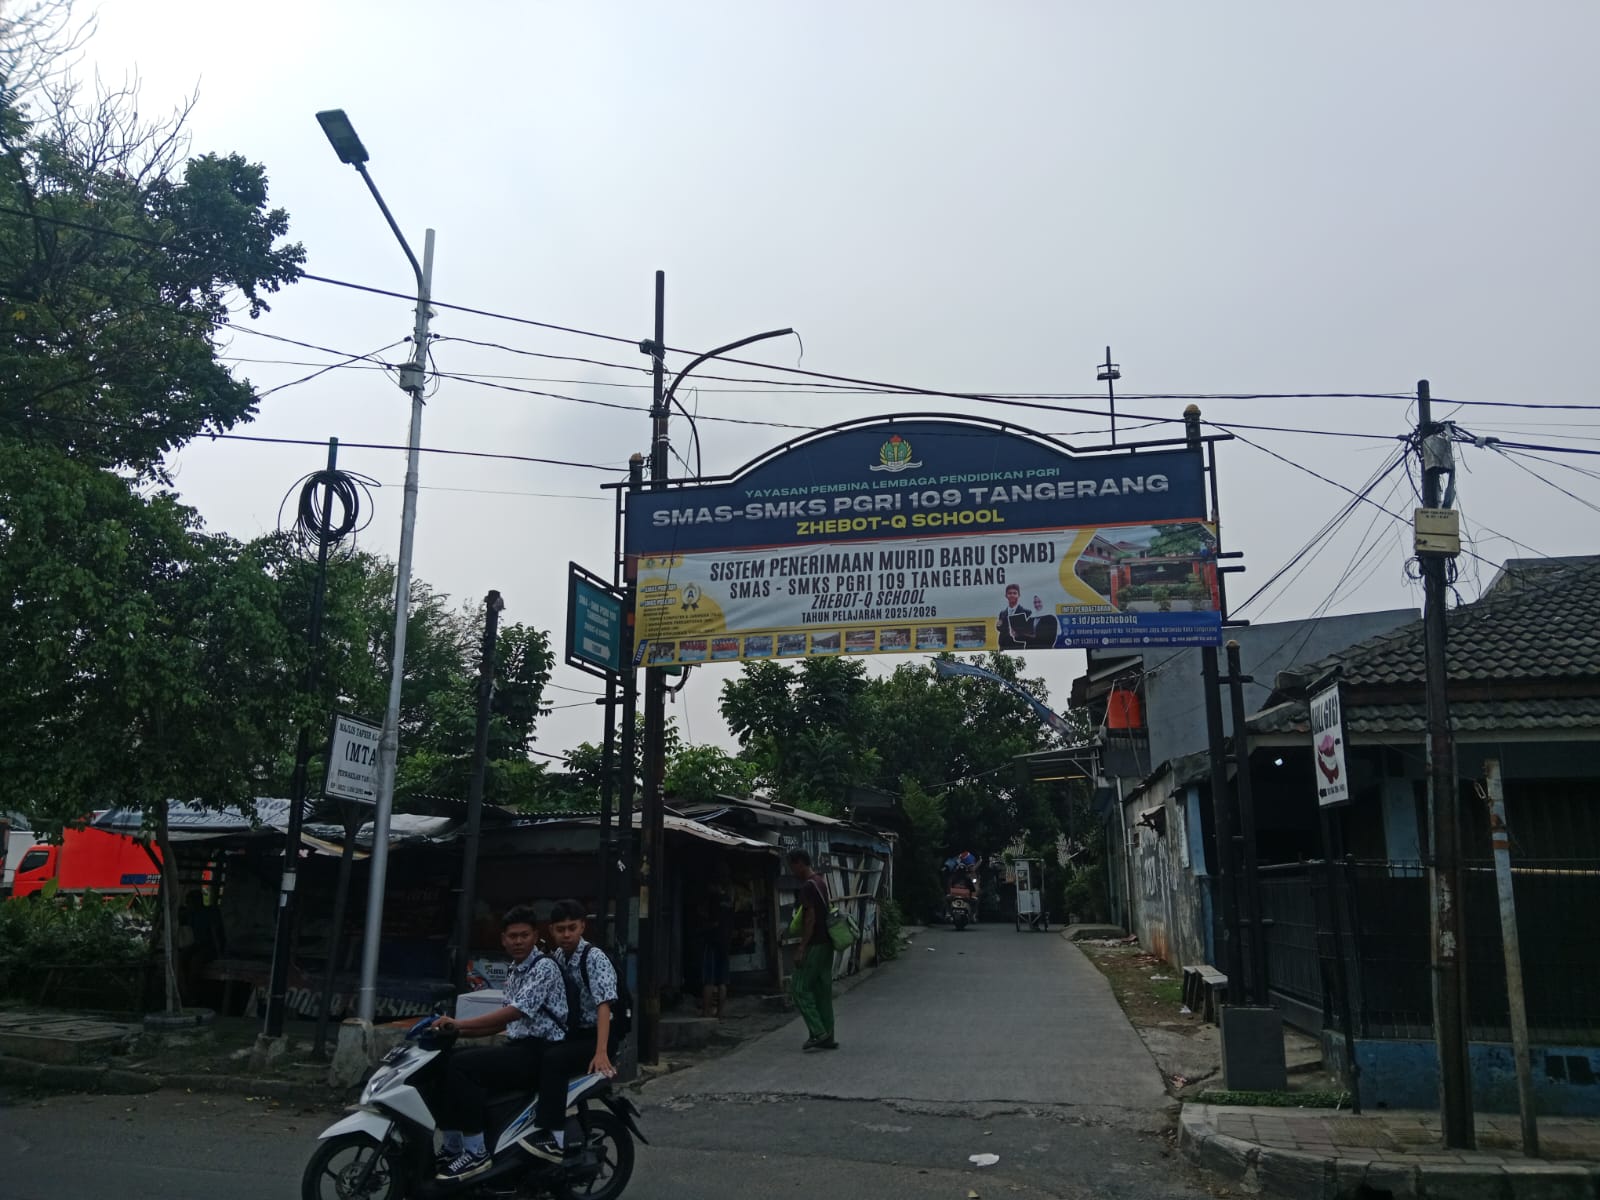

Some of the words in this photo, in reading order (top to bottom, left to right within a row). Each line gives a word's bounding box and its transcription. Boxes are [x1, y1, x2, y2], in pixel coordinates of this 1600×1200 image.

[745, 486, 808, 499] YAYASAN
[810, 481, 870, 494] PEMBINA
[872, 476, 937, 489] LEMBAGA
[940, 469, 1024, 484] PENDIDIKAN
[1026, 467, 1060, 478] PGRI
[652, 498, 827, 527] SMAS-SMKS
[834, 492, 901, 514] PGRI
[908, 488, 962, 509] 109
[968, 474, 1169, 505] TANGERANG
[796, 515, 907, 536] ZHEBOT-Q
[911, 508, 1005, 528] SCHOOL
[710, 559, 765, 581] SISTEM
[769, 551, 874, 577] PENERIMAAN
[879, 548, 935, 571] MURID
[940, 545, 986, 568] BARU
[991, 541, 1055, 566] (SPMB)
[688, 590, 694, 598] A
[730, 580, 770, 599] SMAS
[788, 576, 830, 595] SMKS
[836, 573, 872, 593] PGRI
[877, 572, 905, 590] 109
[911, 567, 1006, 588] TANGERANG
[811, 591, 873, 610] ZHEBOT-Q
[876, 588, 925, 606] SCHOOL
[802, 611, 830, 624] TAHUN
[832, 608, 882, 623] PELAJARAN
[885, 605, 937, 619] 2025/2026
